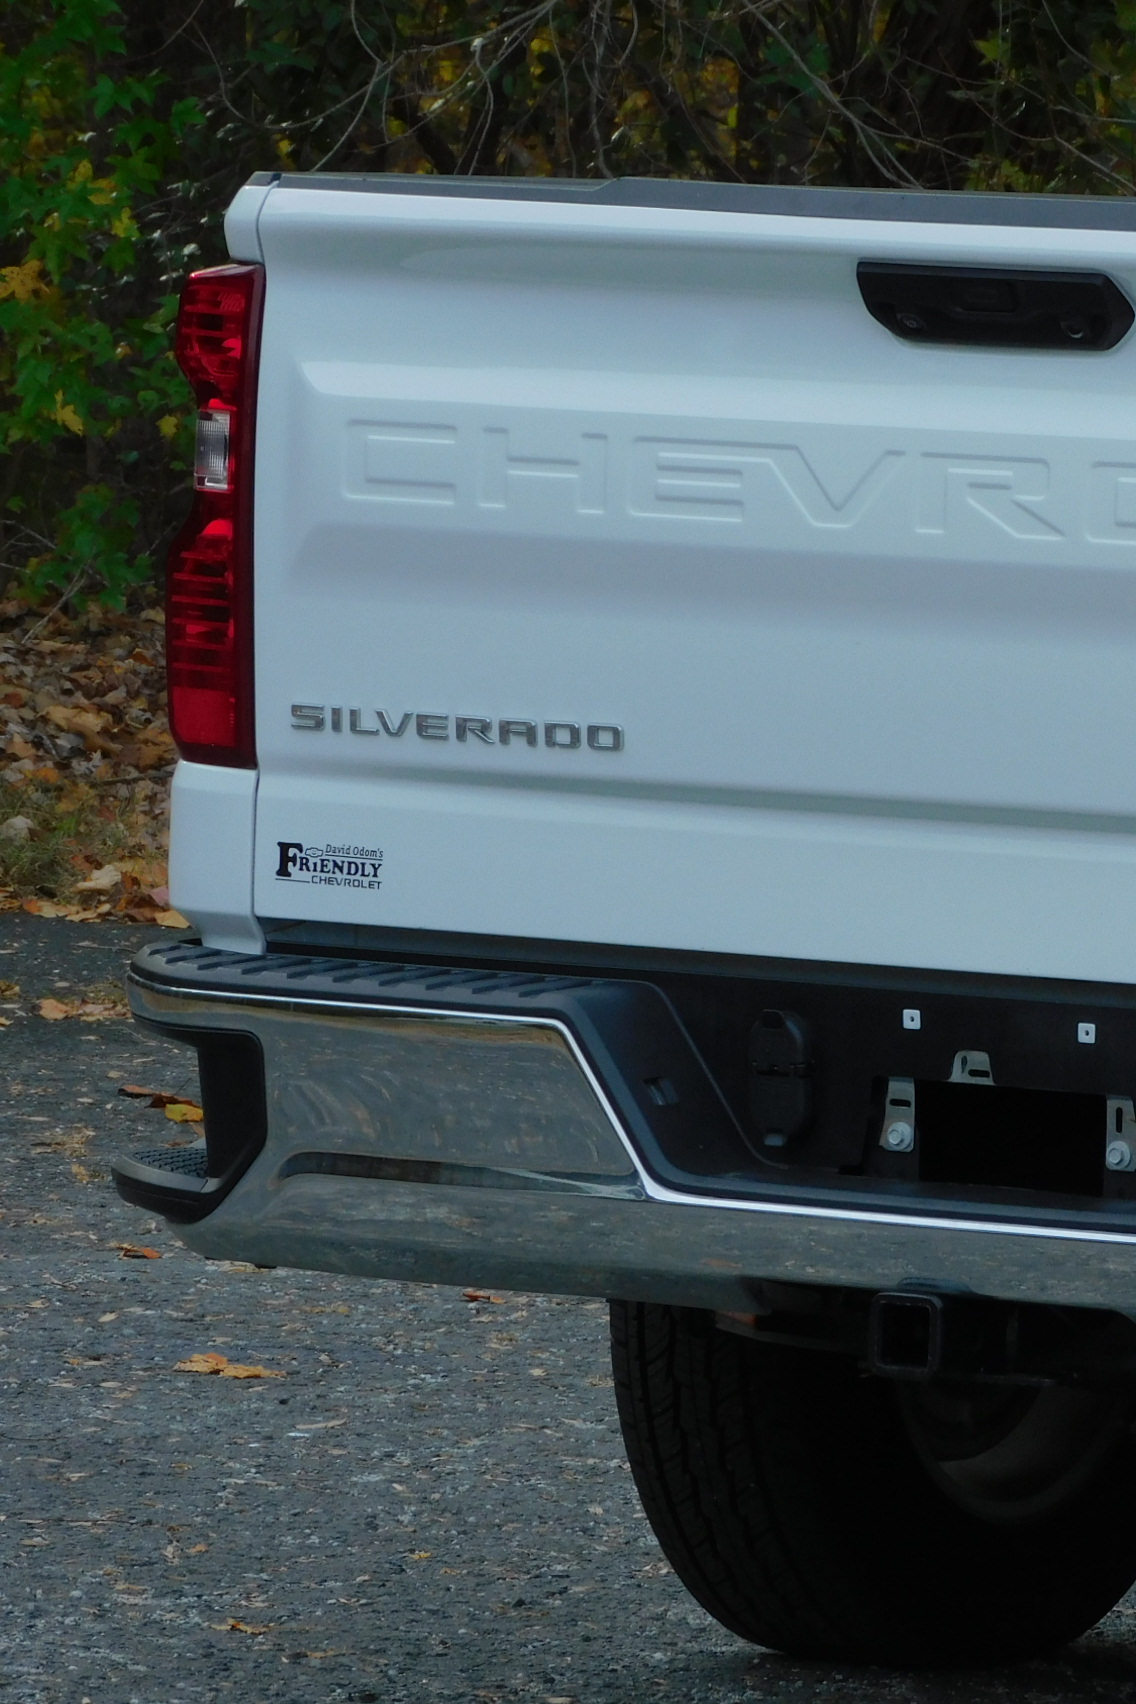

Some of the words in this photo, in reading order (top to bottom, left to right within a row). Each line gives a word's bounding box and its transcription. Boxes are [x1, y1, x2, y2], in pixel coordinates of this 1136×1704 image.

[291, 703, 624, 752] SILVERADO
[325, 844, 351, 856] David
[352, 846, 383, 859] Odom's
[311, 875, 383, 890] CHEVROLET
